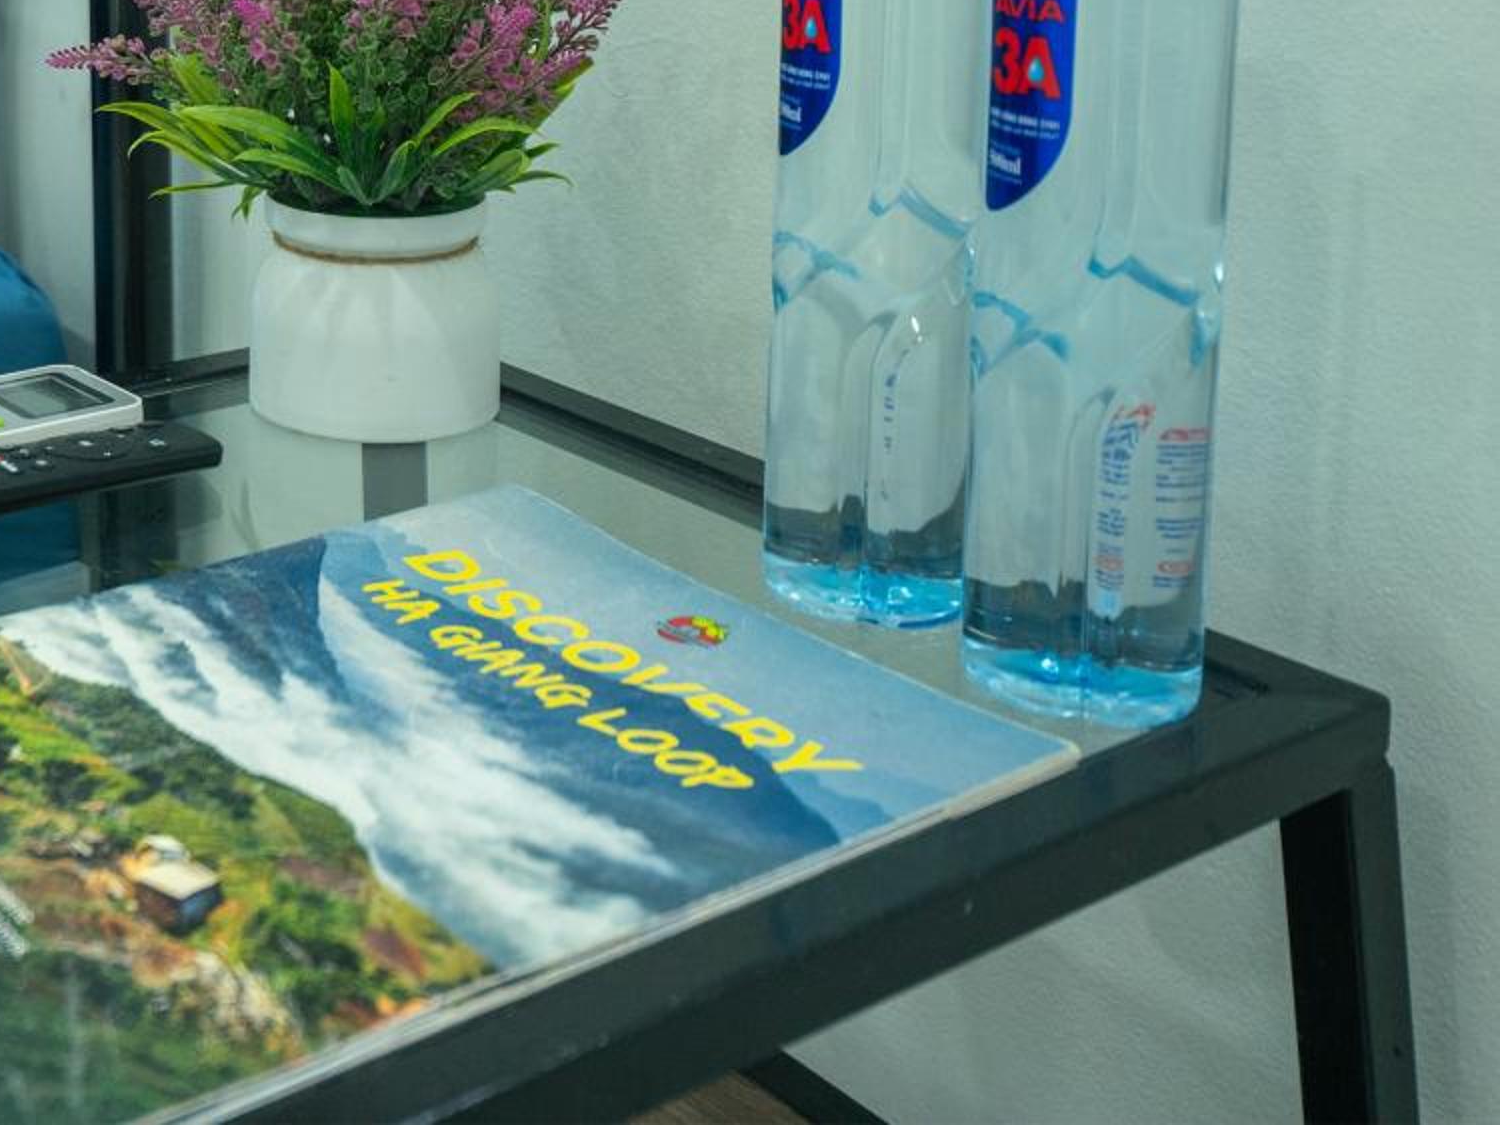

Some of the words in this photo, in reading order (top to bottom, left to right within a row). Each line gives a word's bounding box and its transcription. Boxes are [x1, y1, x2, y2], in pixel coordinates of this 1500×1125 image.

[993, 26, 1061, 100] 3A
[362, 579, 440, 624] HA
[429, 625, 591, 709] GIANG
[577, 707, 754, 789] LOOP
[403, 549, 864, 773] DISCOVERY
